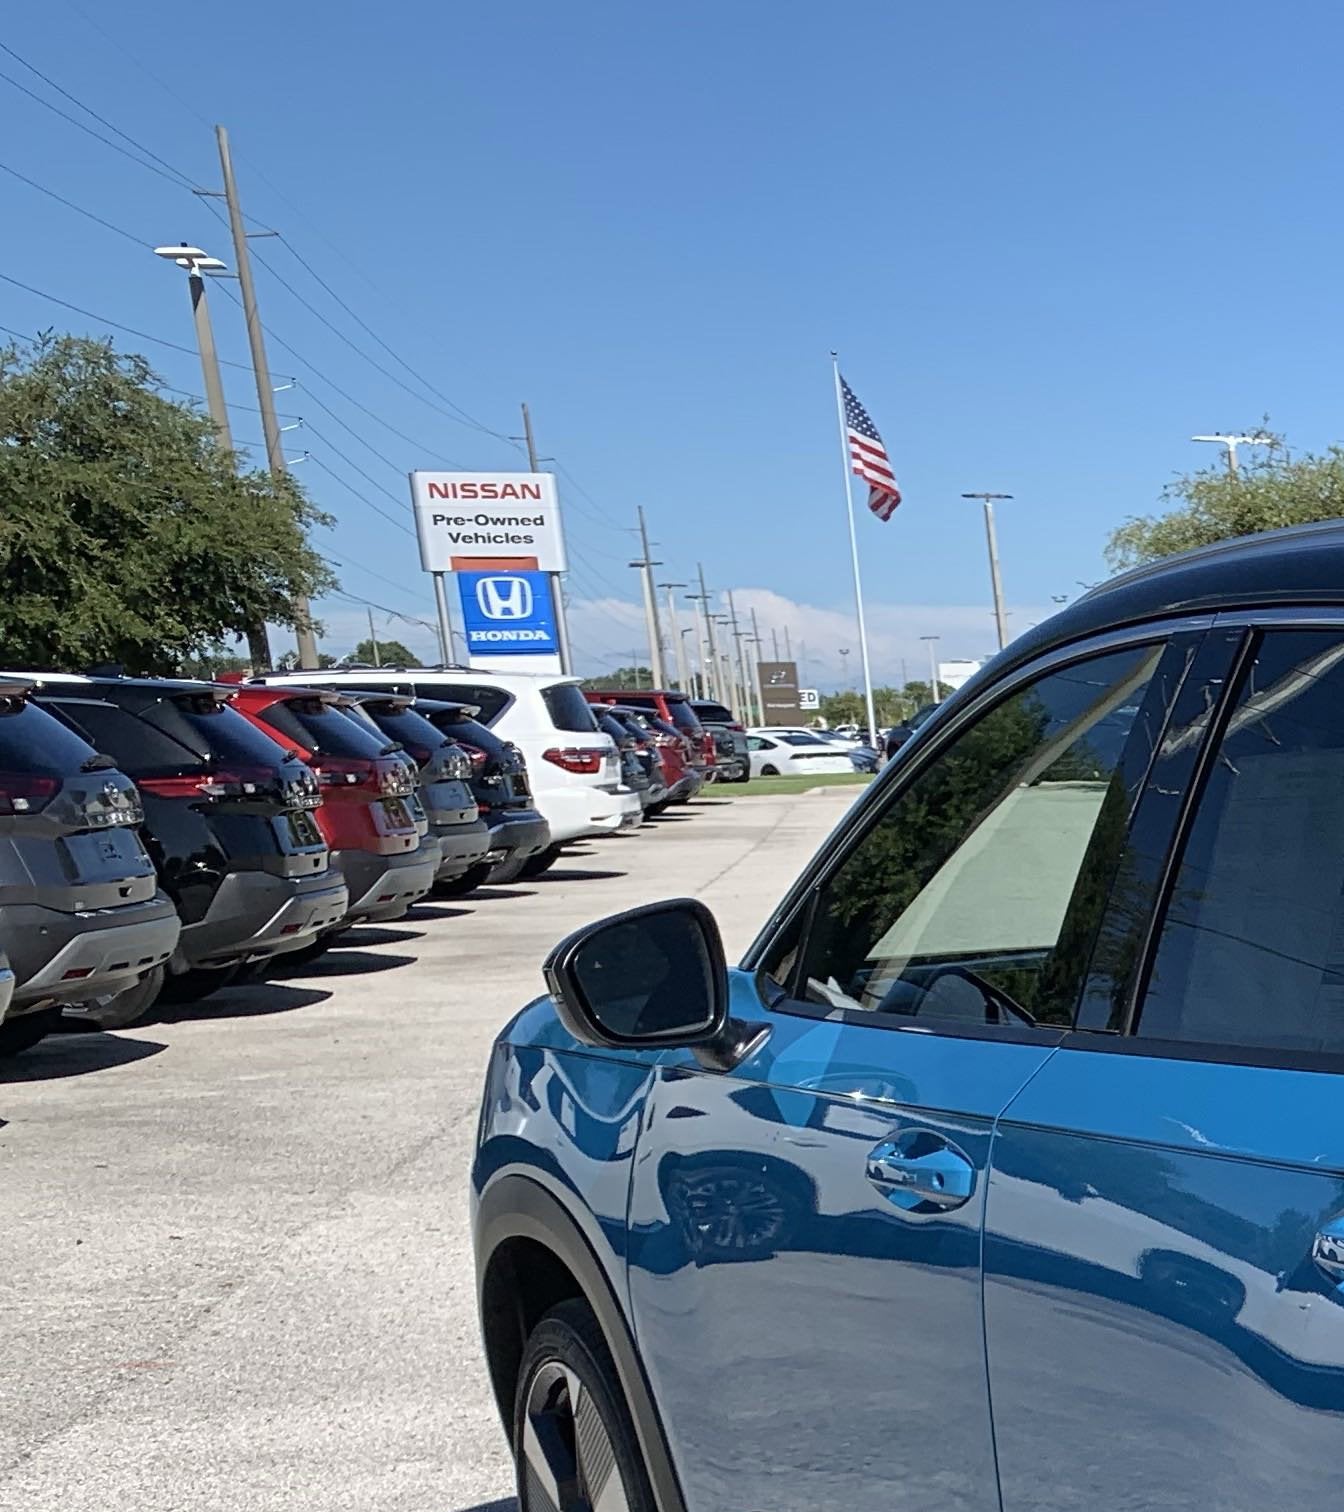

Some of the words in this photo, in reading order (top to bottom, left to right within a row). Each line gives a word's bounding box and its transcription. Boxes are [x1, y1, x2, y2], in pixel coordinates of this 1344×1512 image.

[428, 482, 541, 500] NISSAN
[433, 514, 544, 526] Pre-Owned
[448, 532, 534, 544] Vehicles
[470, 630, 550, 641] HONDA
